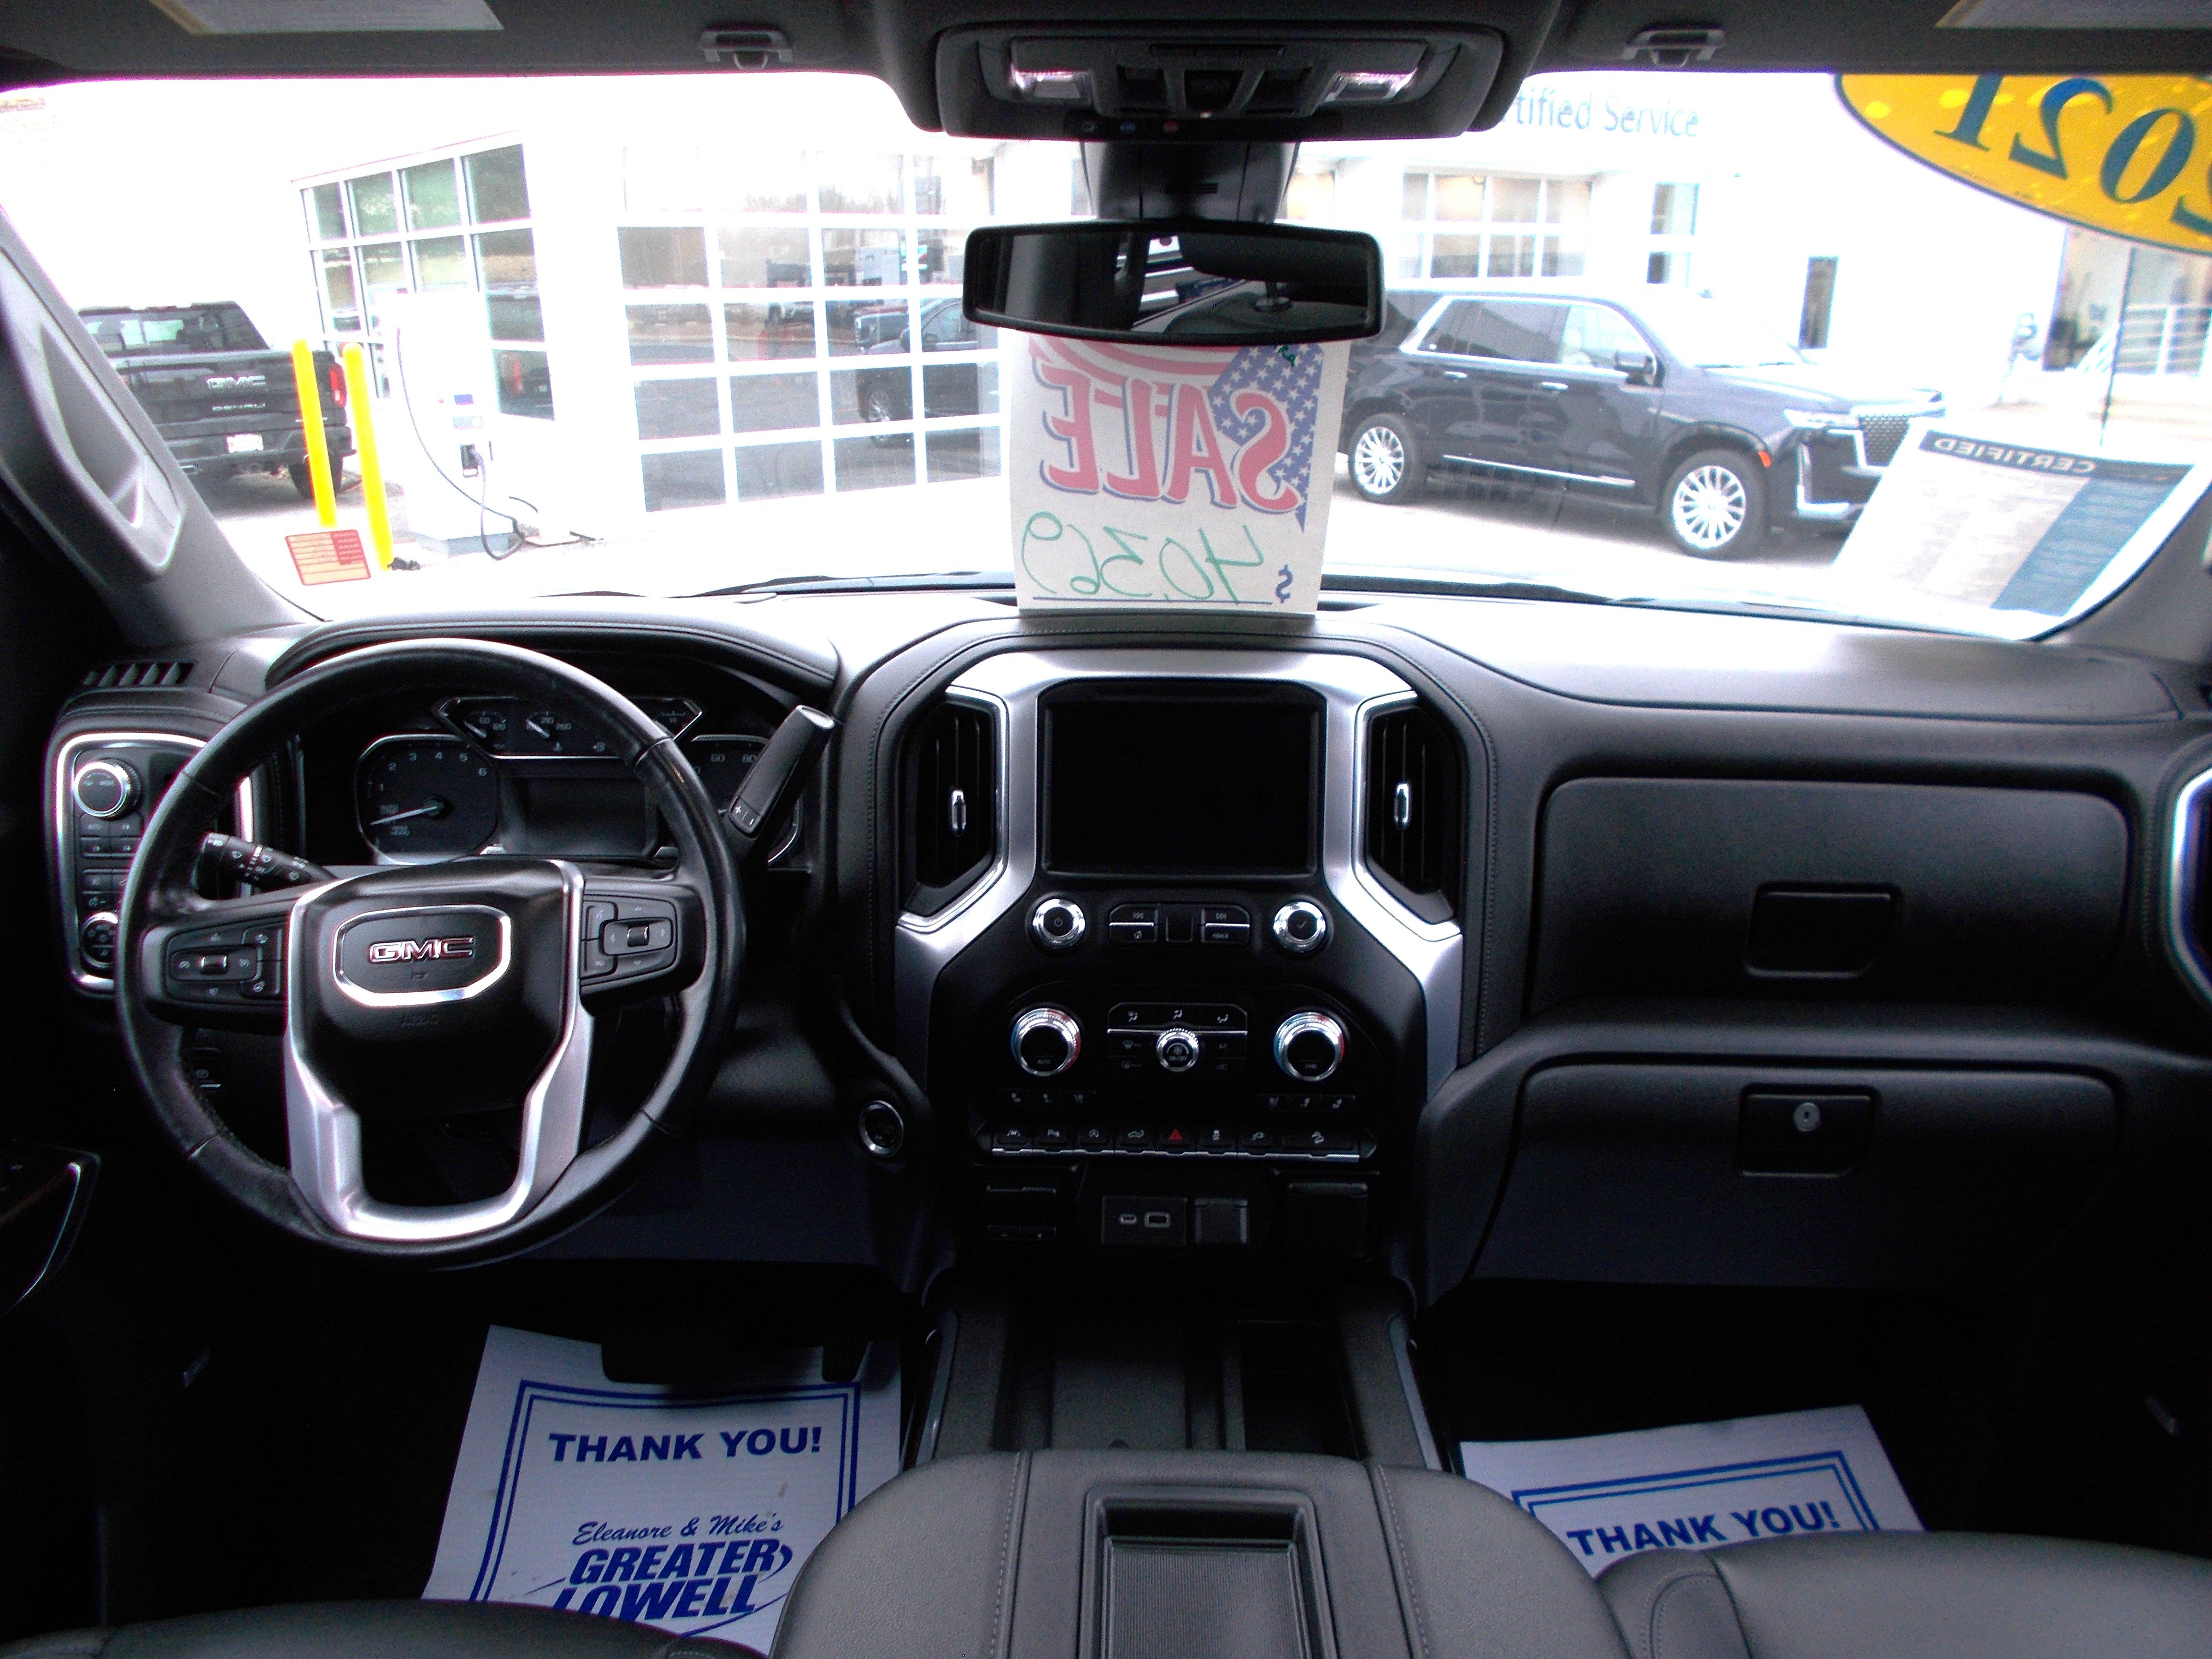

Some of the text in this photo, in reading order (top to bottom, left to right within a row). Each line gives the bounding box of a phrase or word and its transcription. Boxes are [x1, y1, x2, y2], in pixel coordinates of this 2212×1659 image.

[1503, 86, 1699, 137] tified Service
[206, 375, 266, 389] GMC
[409, 752, 418, 762] 3
[435, 751, 444, 760] 4
[459, 752, 469, 762] 5
[369, 937, 474, 962] GMC
[548, 1426, 822, 1463] THANK YOU!
[571, 1512, 784, 1546] Eleanore & Mike's
[1566, 1501, 1840, 1556] THANK YOU!
[569, 1539, 781, 1585] GREATER
